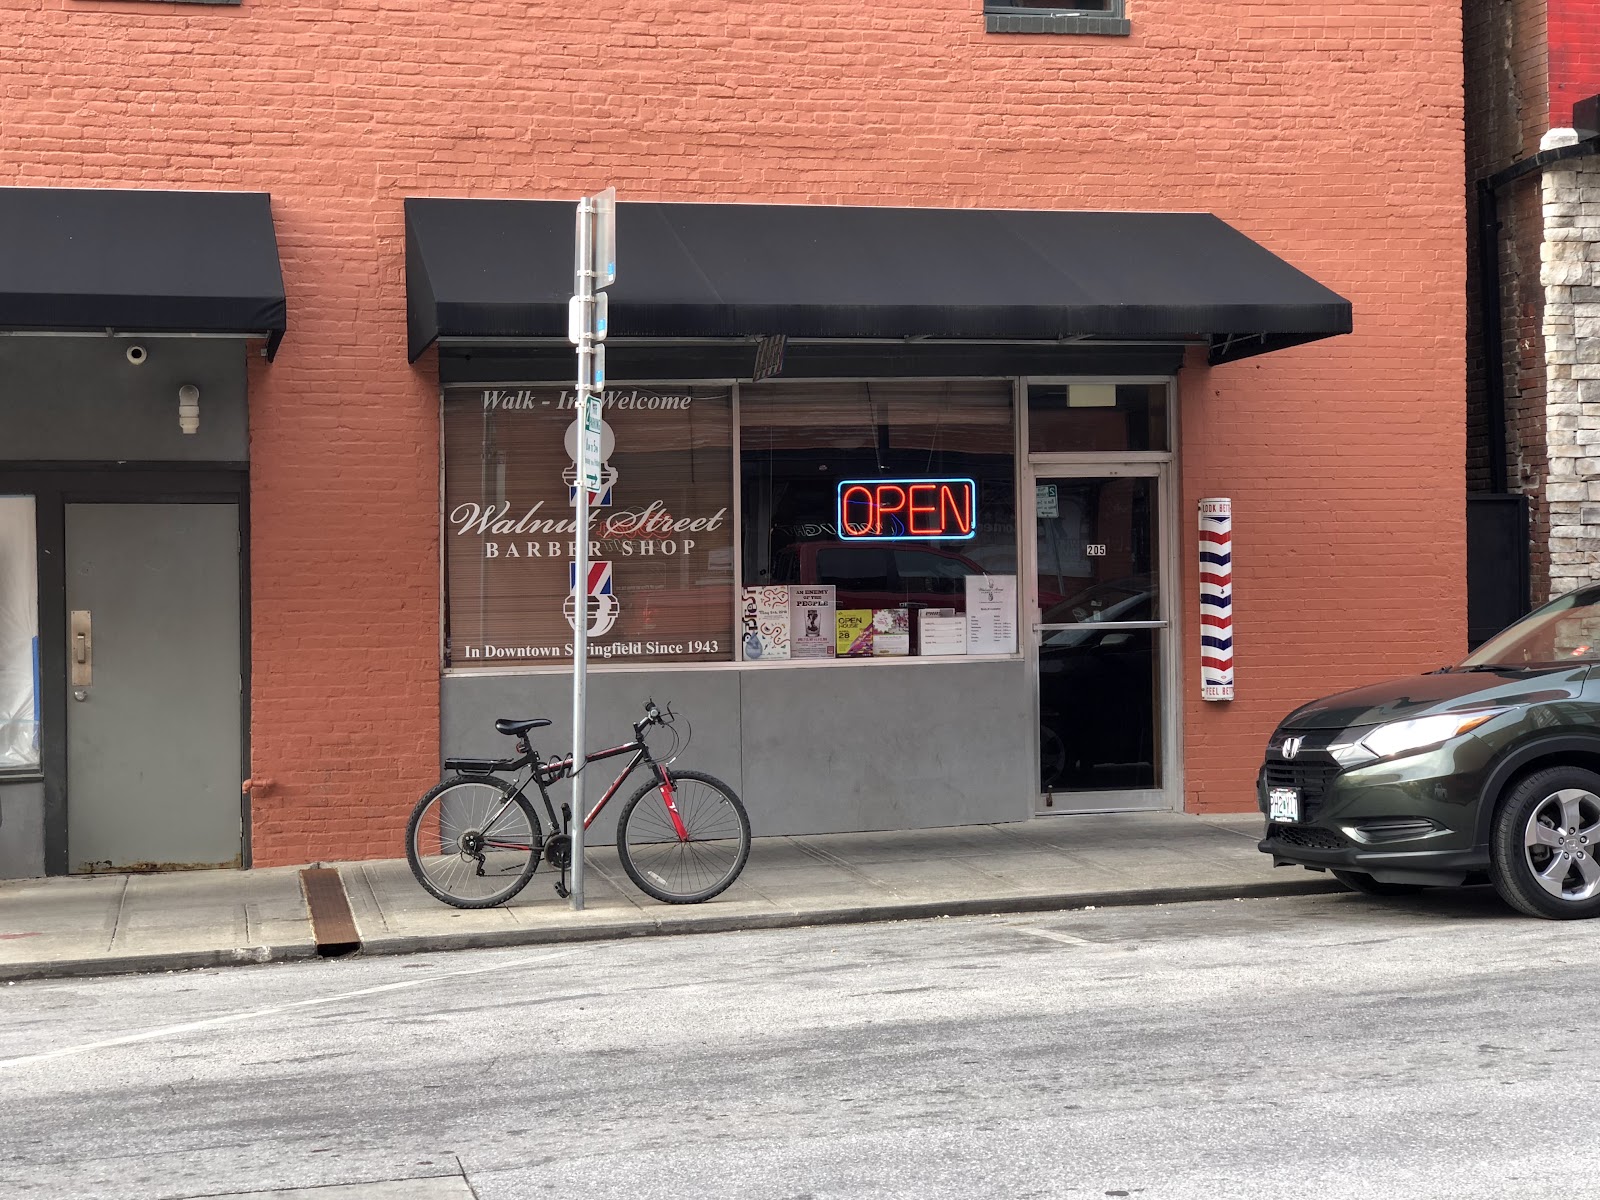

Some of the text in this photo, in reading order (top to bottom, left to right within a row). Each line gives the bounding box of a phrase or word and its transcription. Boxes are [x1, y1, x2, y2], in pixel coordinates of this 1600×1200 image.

[482, 391, 535, 410] Walk
[600, 390, 692, 410] Welcome
[843, 485, 970, 535] OPEN
[1202, 504, 1216, 513] LOOK
[450, 500, 601, 536] Walnut
[603, 500, 727, 538] Street
[622, 540, 695, 556] SHOP
[1087, 545, 1106, 556] 205
[465, 640, 719, 659] In Downtown Singfield Since 1943
[1206, 687, 1219, 696] FEEL
